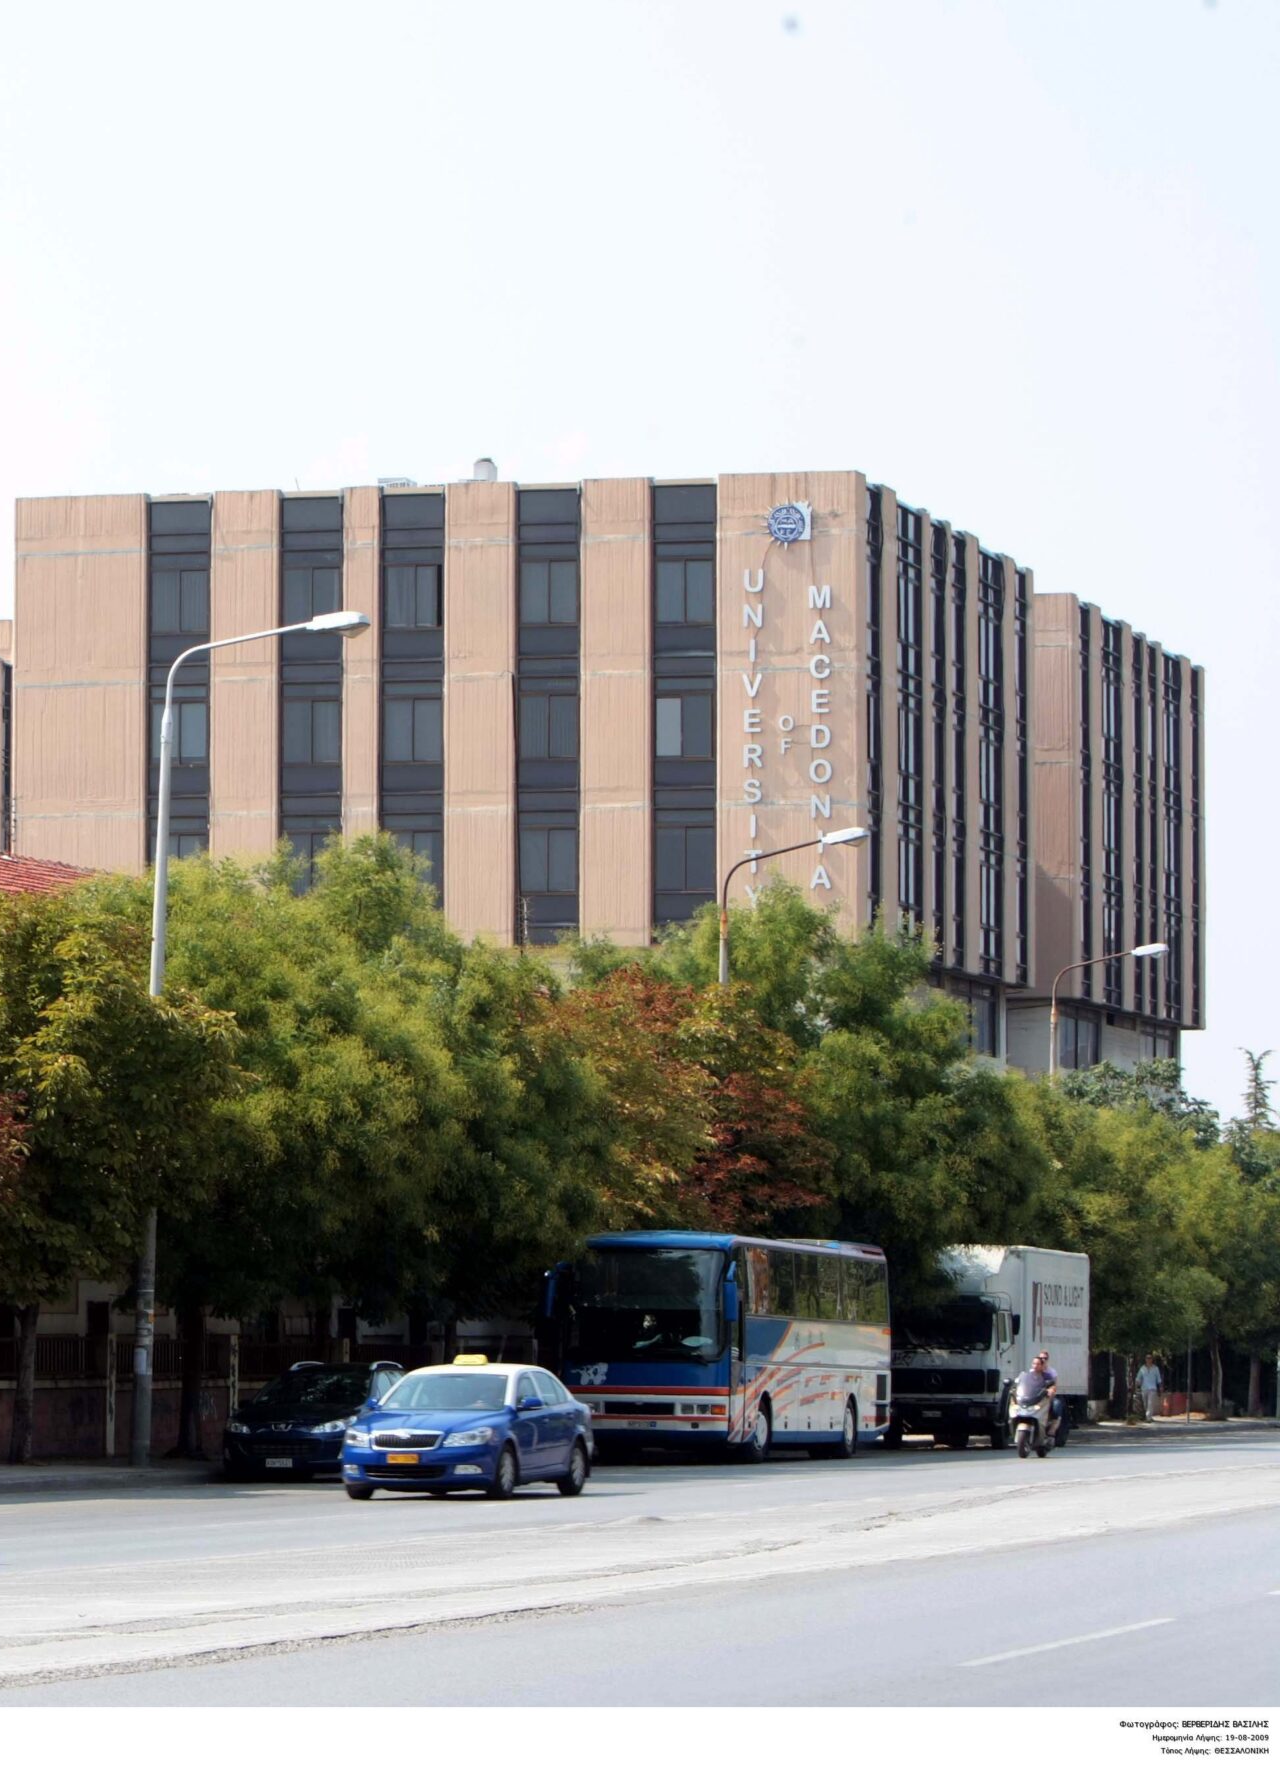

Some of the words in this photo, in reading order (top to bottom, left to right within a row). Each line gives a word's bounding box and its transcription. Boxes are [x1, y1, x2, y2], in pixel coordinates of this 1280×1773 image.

[742, 568, 765, 912] UNIVERSITY
[778, 715, 795, 757] OF
[808, 584, 832, 890] MACEDONIA
